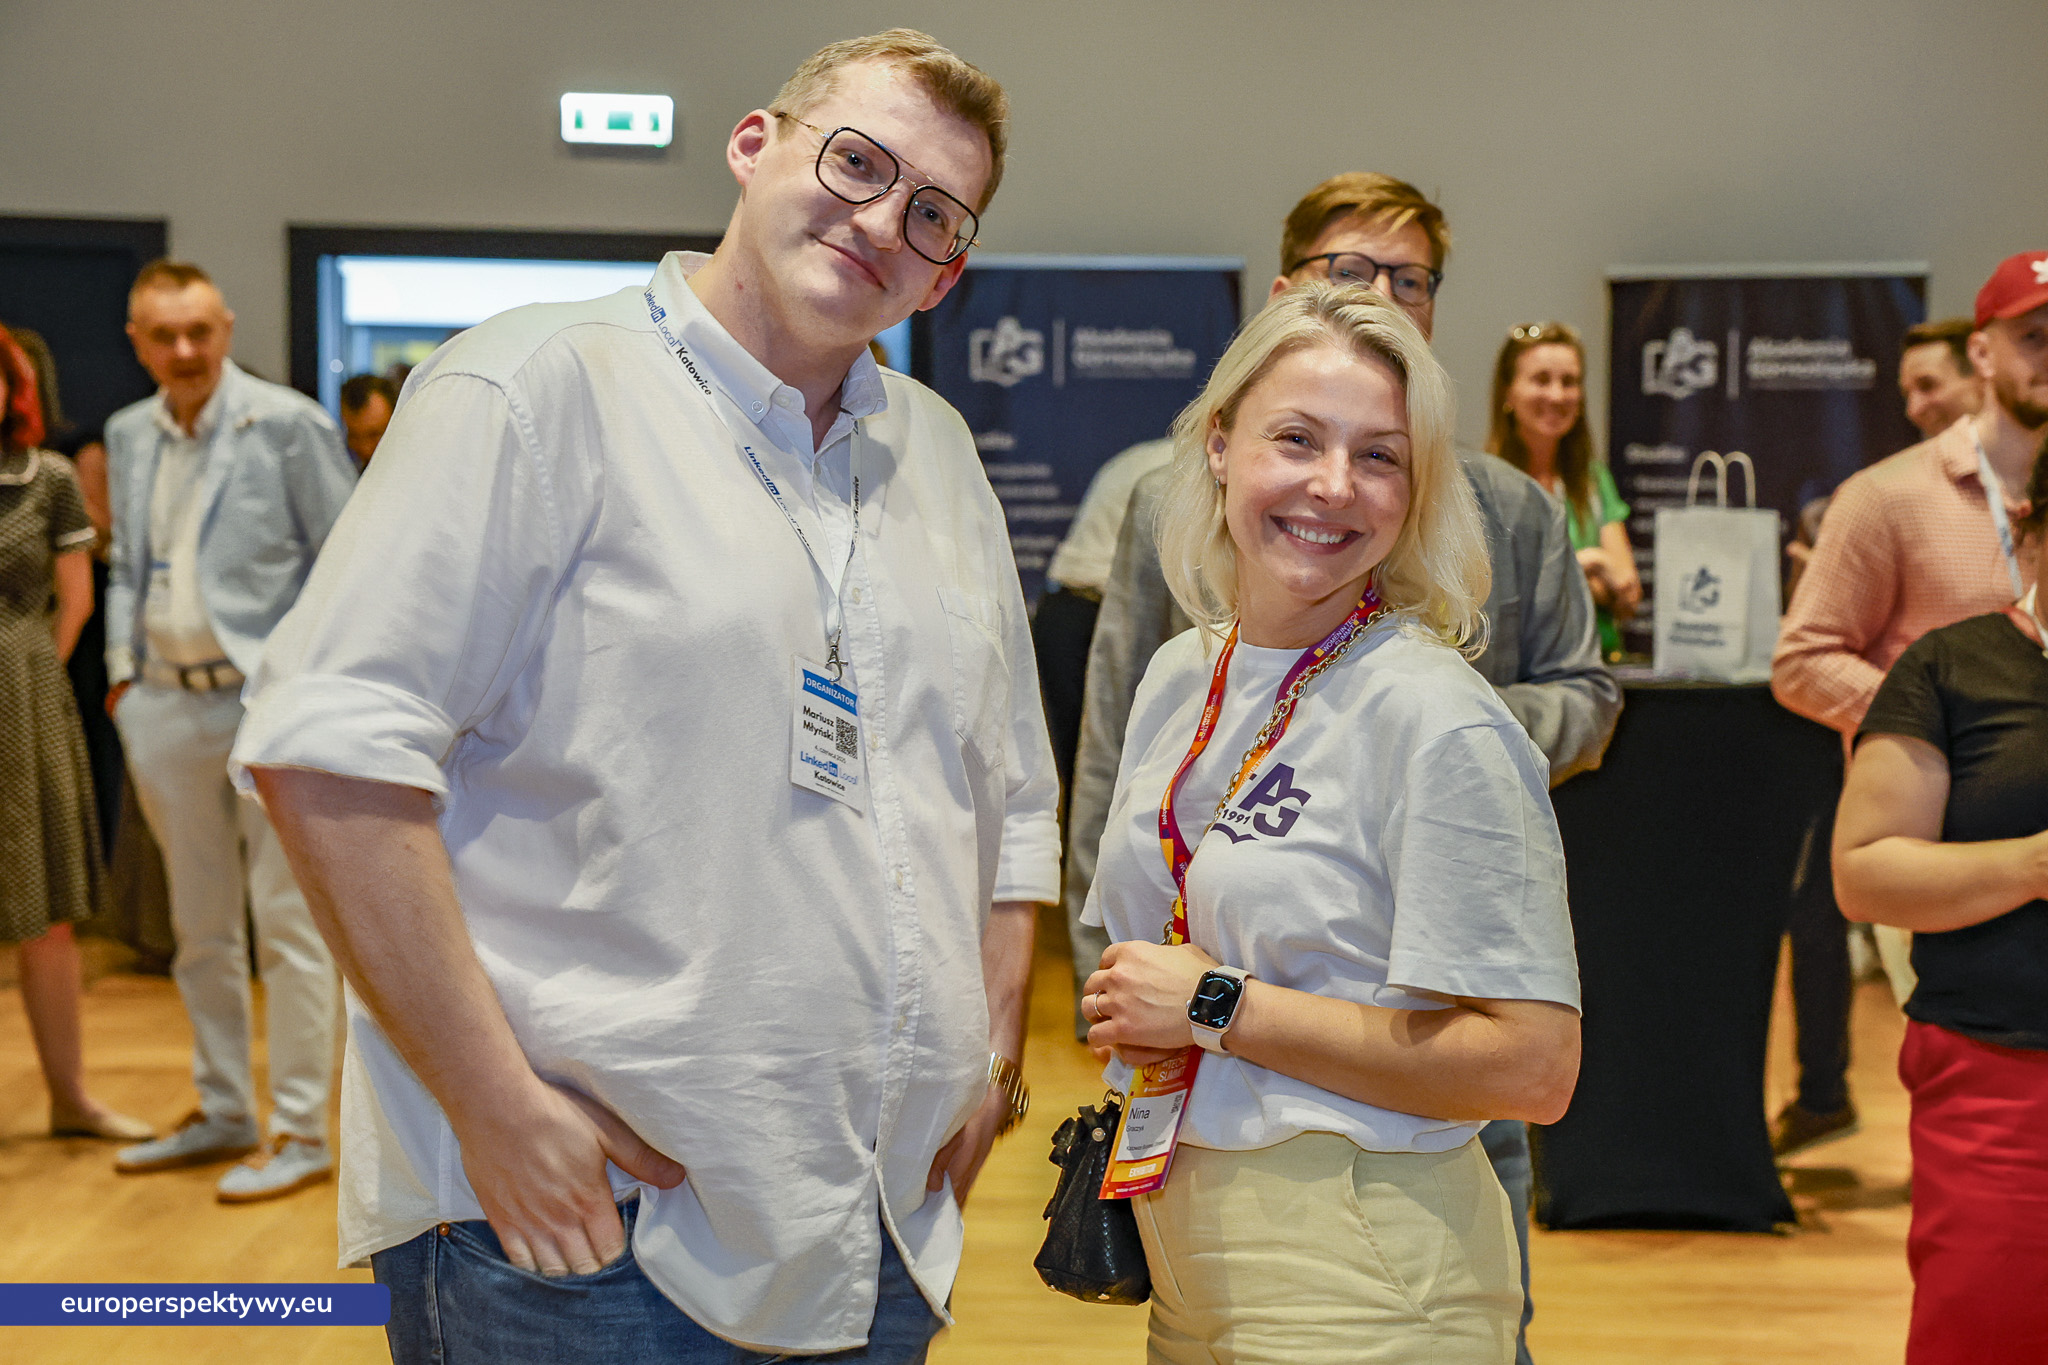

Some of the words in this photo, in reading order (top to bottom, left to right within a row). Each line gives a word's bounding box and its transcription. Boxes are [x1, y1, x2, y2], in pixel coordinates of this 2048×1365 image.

[676, 346, 712, 395] Katowice
[1323, 630, 1342, 652] WOMEN
[1345, 611, 1359, 627] TECH
[806, 677, 855, 708] ORGANIZATOR
[803, 706, 835, 727] Mariusz
[803, 720, 834, 742] Młyński
[814, 770, 846, 792] Katowice
[1221, 809, 1251, 825] 1991
[1129, 1107, 1150, 1120] Nina
